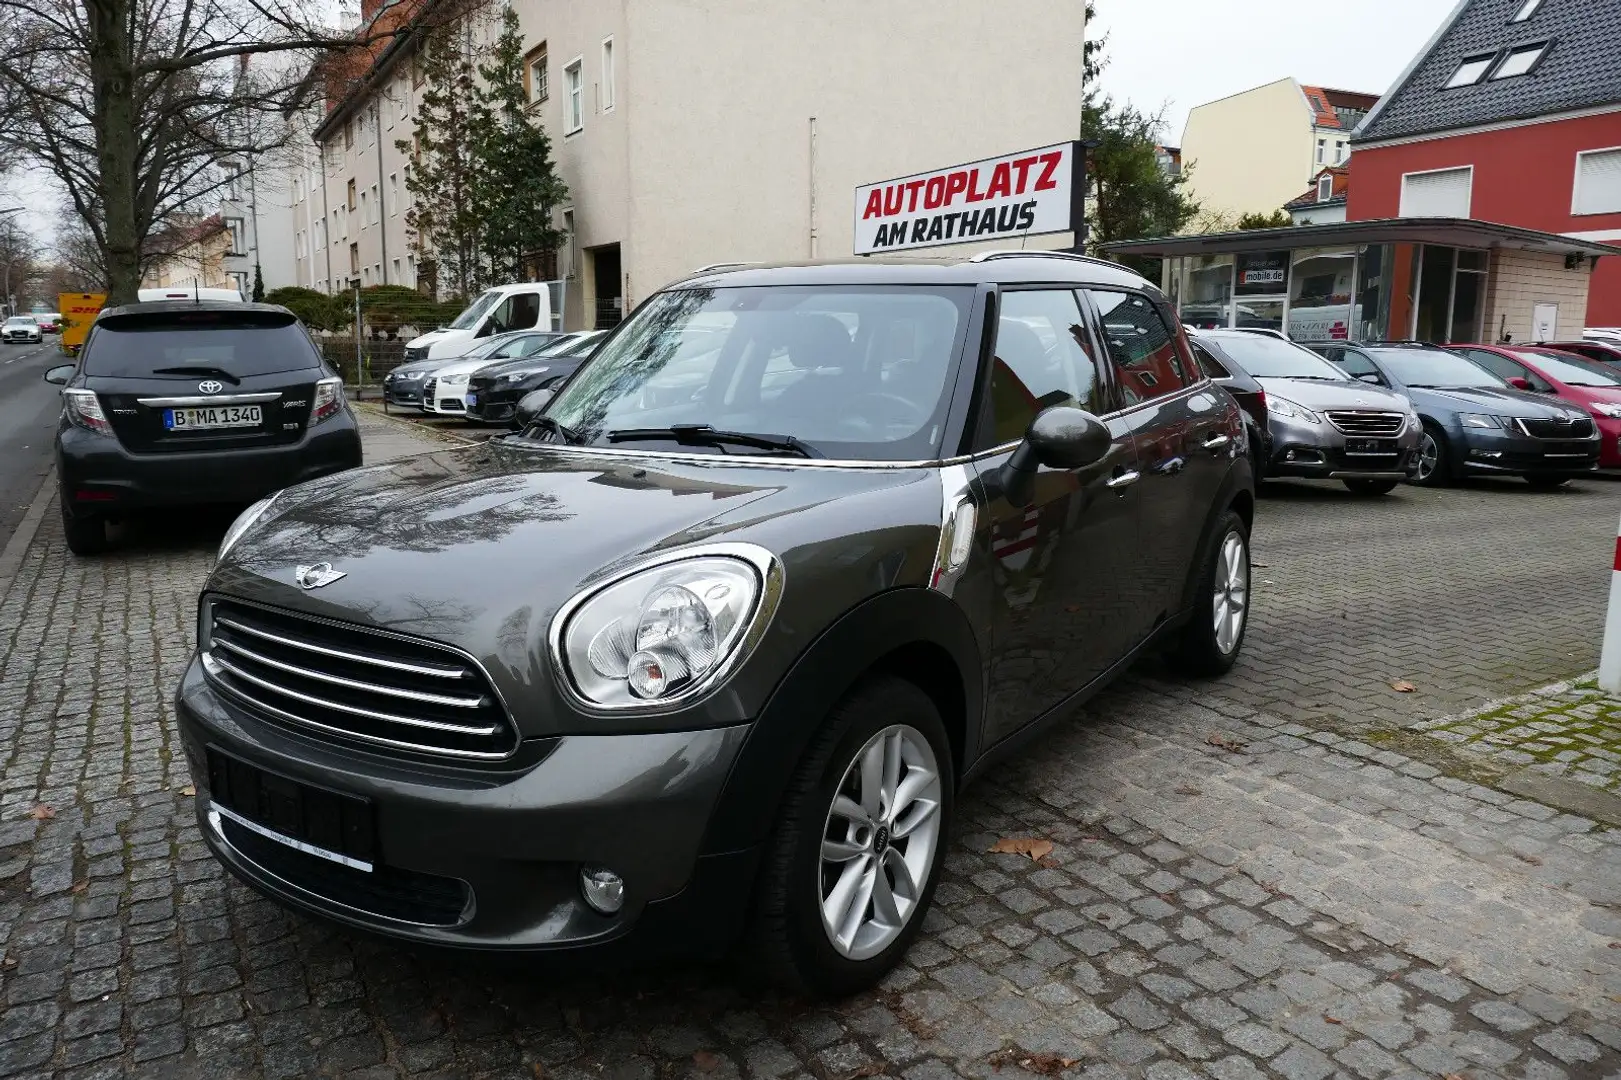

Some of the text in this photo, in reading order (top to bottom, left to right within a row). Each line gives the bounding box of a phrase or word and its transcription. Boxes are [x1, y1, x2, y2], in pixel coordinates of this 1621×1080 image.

[862, 151, 1063, 219] AUTOPLATZ
[873, 200, 1038, 248] AM RATHAUS
[1246, 271, 1283, 281] mobile.de
[175, 411, 186, 426] B
[196, 409, 218, 424] MA
[220, 407, 260, 423] 1340
